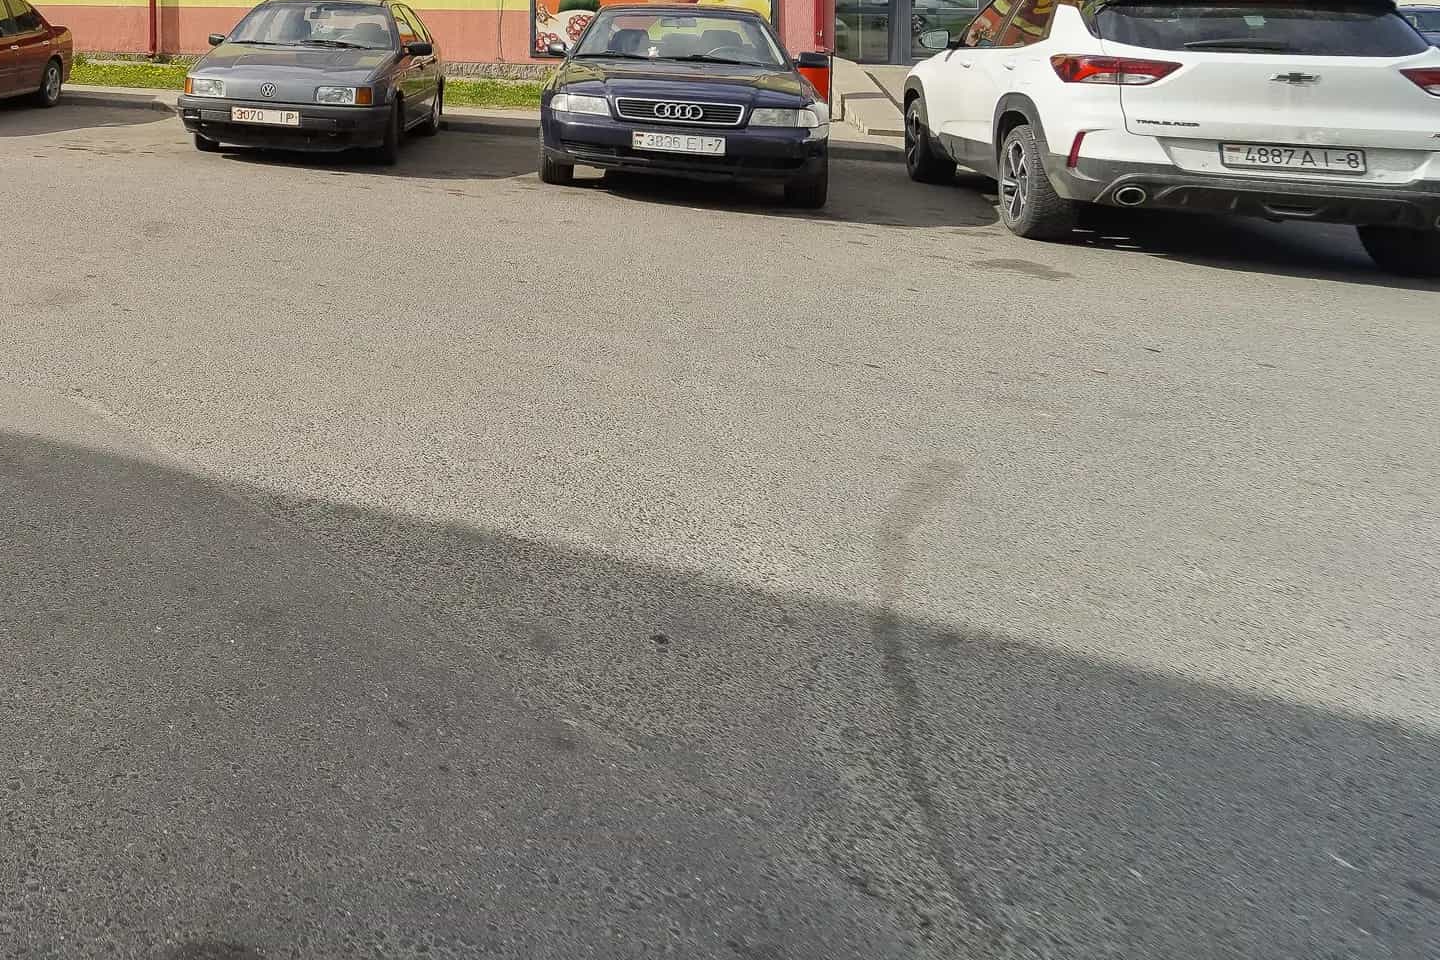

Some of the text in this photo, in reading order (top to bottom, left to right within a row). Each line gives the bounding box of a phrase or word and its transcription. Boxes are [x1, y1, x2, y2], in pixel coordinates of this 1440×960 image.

[236, 109, 264, 121] 3070
[686, 137, 722, 152] EI-7
[1245, 146, 1296, 165] 4887
